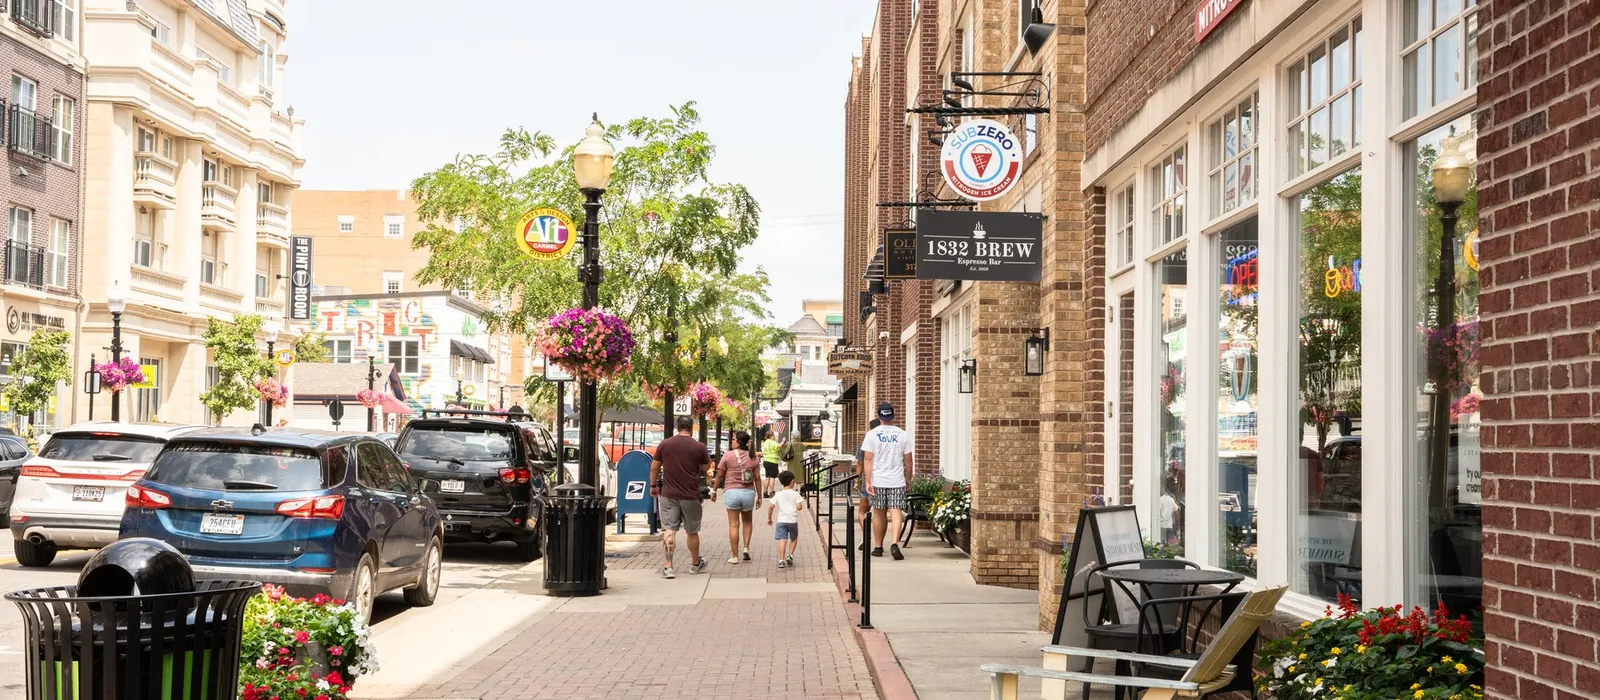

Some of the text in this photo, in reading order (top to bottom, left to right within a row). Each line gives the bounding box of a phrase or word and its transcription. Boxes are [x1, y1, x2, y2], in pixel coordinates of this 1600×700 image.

[1199, 0, 1233, 34] NITR
[951, 175, 979, 196] NITROGEN
[993, 176, 1012, 193] CREAM
[522, 211, 539, 224] ARTS
[546, 210, 571, 225] DESIGN
[529, 249, 562, 259] DISTRICT
[927, 240, 1034, 258] 1832 BREW
[957, 257, 988, 266] Espresso
[294, 246, 309, 318] PINT ROOM
[675, 403, 688, 413] 20
